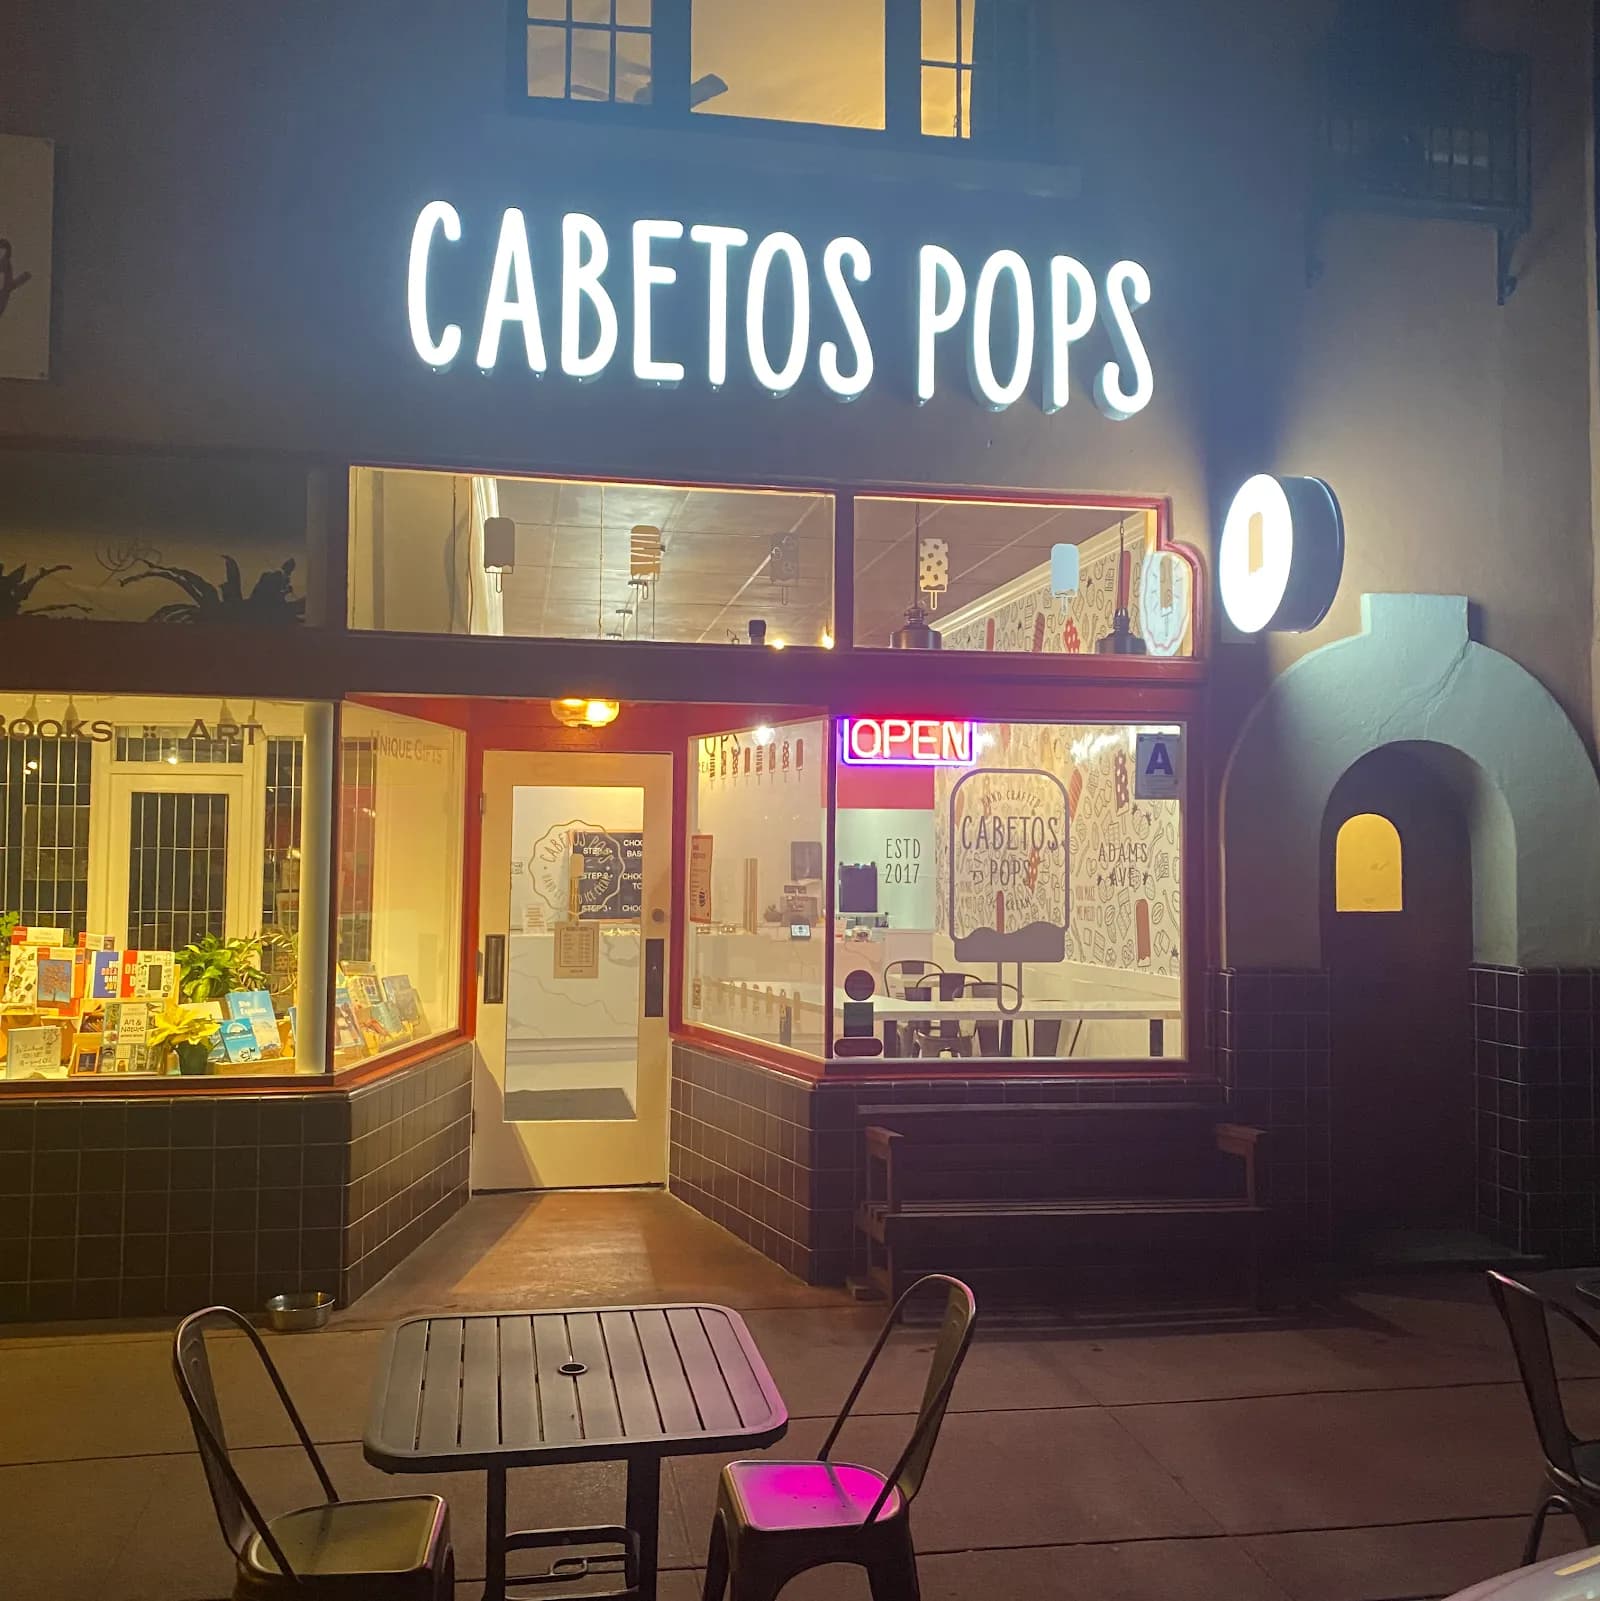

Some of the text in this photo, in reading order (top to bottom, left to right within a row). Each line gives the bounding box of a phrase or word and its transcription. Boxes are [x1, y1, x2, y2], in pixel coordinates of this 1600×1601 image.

[407, 200, 1155, 420] CABETOS POPS
[0, 714, 263, 745] OOKS ART
[851, 718, 970, 761] OPEN
[1145, 743, 1174, 775] A
[961, 815, 1059, 851] CABETOS
[886, 838, 921, 859] ESTD
[1098, 842, 1148, 863] ADAMS
[885, 863, 920, 884] 2017
[989, 859, 1032, 887] POPS
[1110, 867, 1135, 887] AVE
